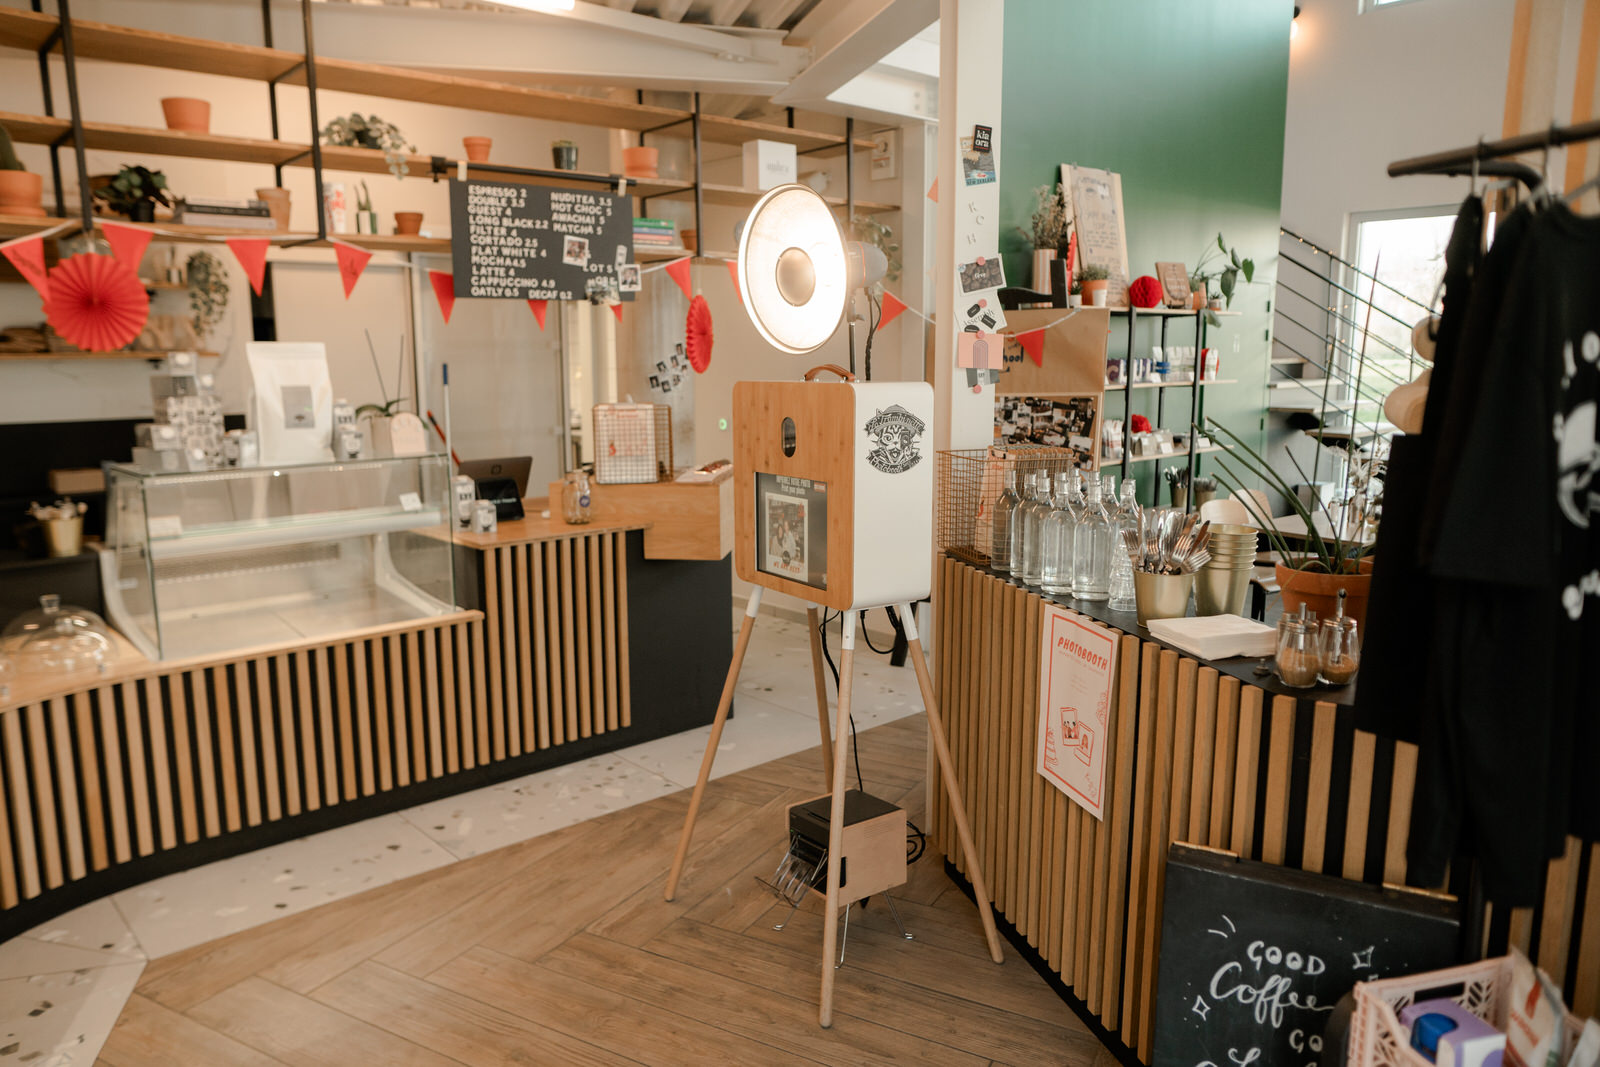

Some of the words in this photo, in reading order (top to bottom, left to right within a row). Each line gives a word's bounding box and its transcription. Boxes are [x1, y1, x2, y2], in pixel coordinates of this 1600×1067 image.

[976, 130, 990, 140] kia
[975, 139, 989, 148] ora
[468, 184, 517, 198] ESPRESSO
[468, 195, 507, 207] DOUBLE
[467, 204, 503, 216] GUEST
[505, 207, 512, 217] 4
[550, 202, 572, 213] HOT
[574, 204, 602, 215] CHOC
[469, 214, 500, 226] LONG
[502, 217, 534, 229] BLACK
[470, 225, 507, 236] FILTER
[510, 229, 518, 237] 4
[553, 222, 594, 235] MATCHA
[470, 234, 523, 247] CORTADO
[471, 245, 499, 256] FLAT
[501, 247, 537, 258] WHITE
[540, 249, 547, 258] 4
[471, 256, 512, 267] MOCHA
[472, 265, 506, 277] LATTE
[508, 267, 515, 277] 4
[470, 276, 539, 288] CAPPUCCINO
[470, 286, 504, 297] OATLY
[528, 289, 558, 300] DECAF
[1002, 345, 1024, 363] hool
[1057, 636, 1108, 671] PHOTOBOOTH
[1247, 940, 1326, 975] GOOD
[1209, 961, 1336, 1029] Coffee
